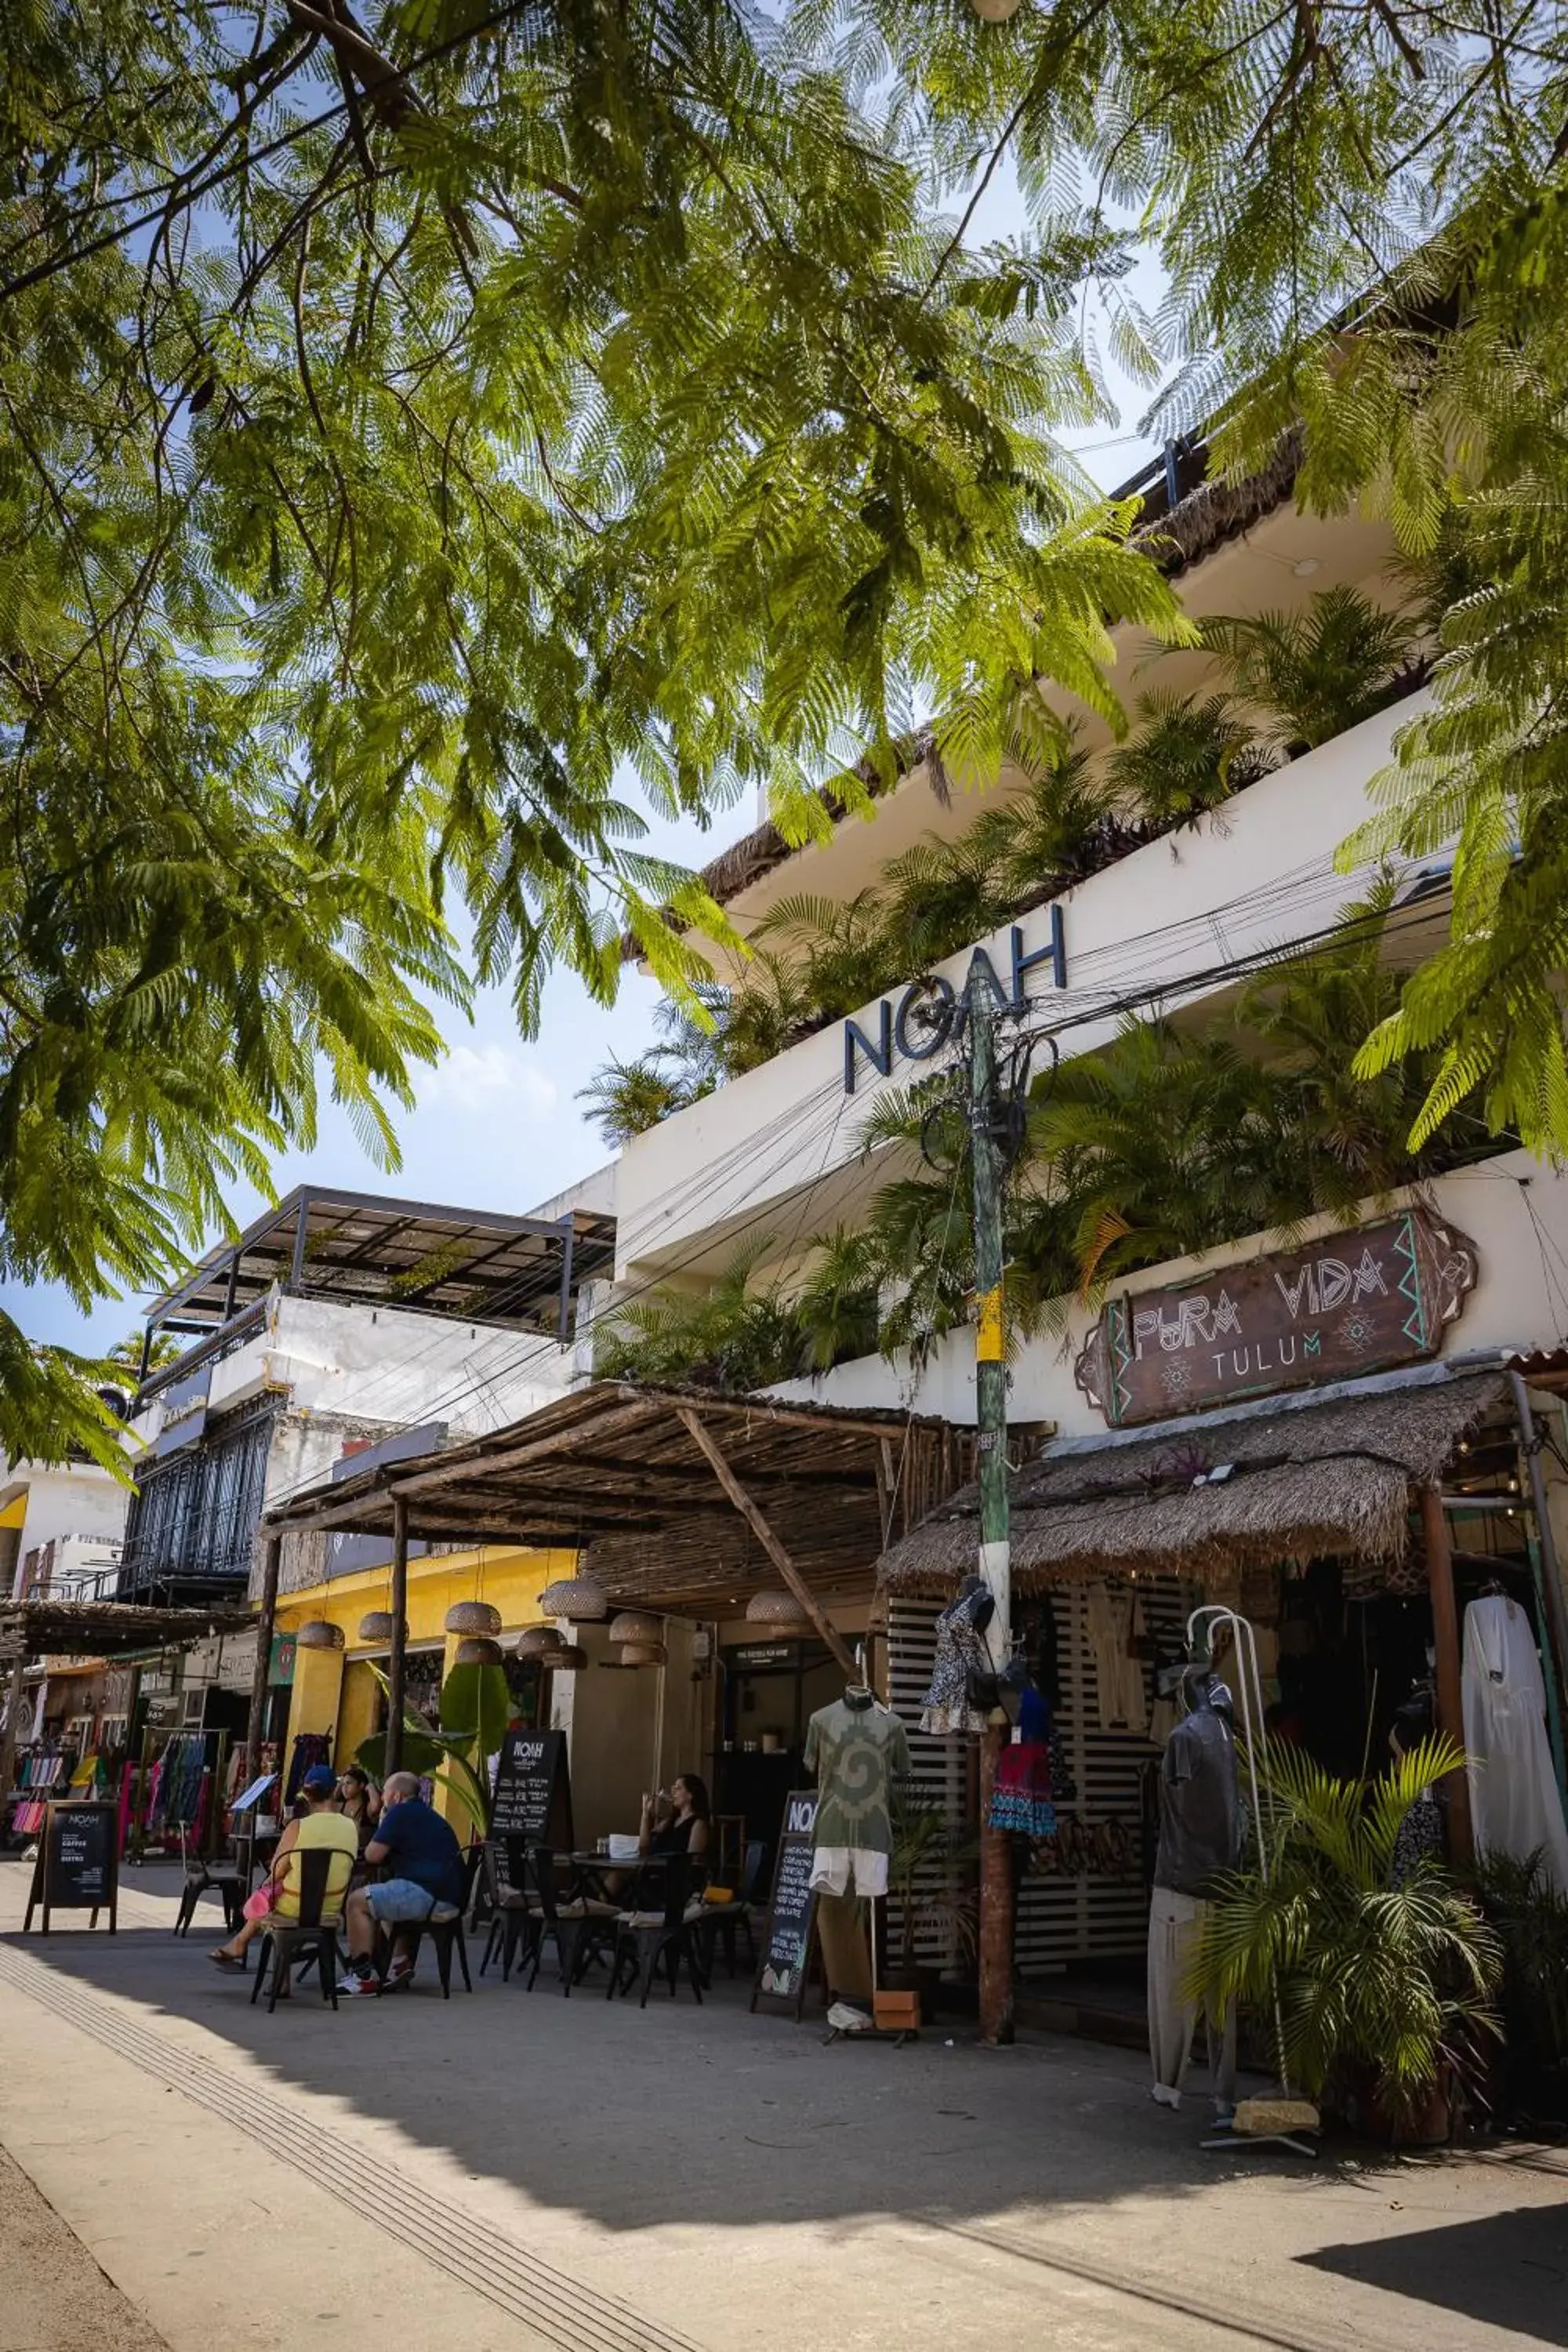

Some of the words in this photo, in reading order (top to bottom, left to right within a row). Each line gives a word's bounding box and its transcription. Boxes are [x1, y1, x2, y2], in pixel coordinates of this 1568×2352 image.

[844, 903, 1066, 1094] NOAH
[1134, 1288, 1243, 1360] PURA
[1275, 1247, 1389, 1318] VIDA
[1212, 1330, 1321, 1380] TULUM
[514, 1740, 544, 1757] NOAH
[69, 1814, 100, 1824] NOAH
